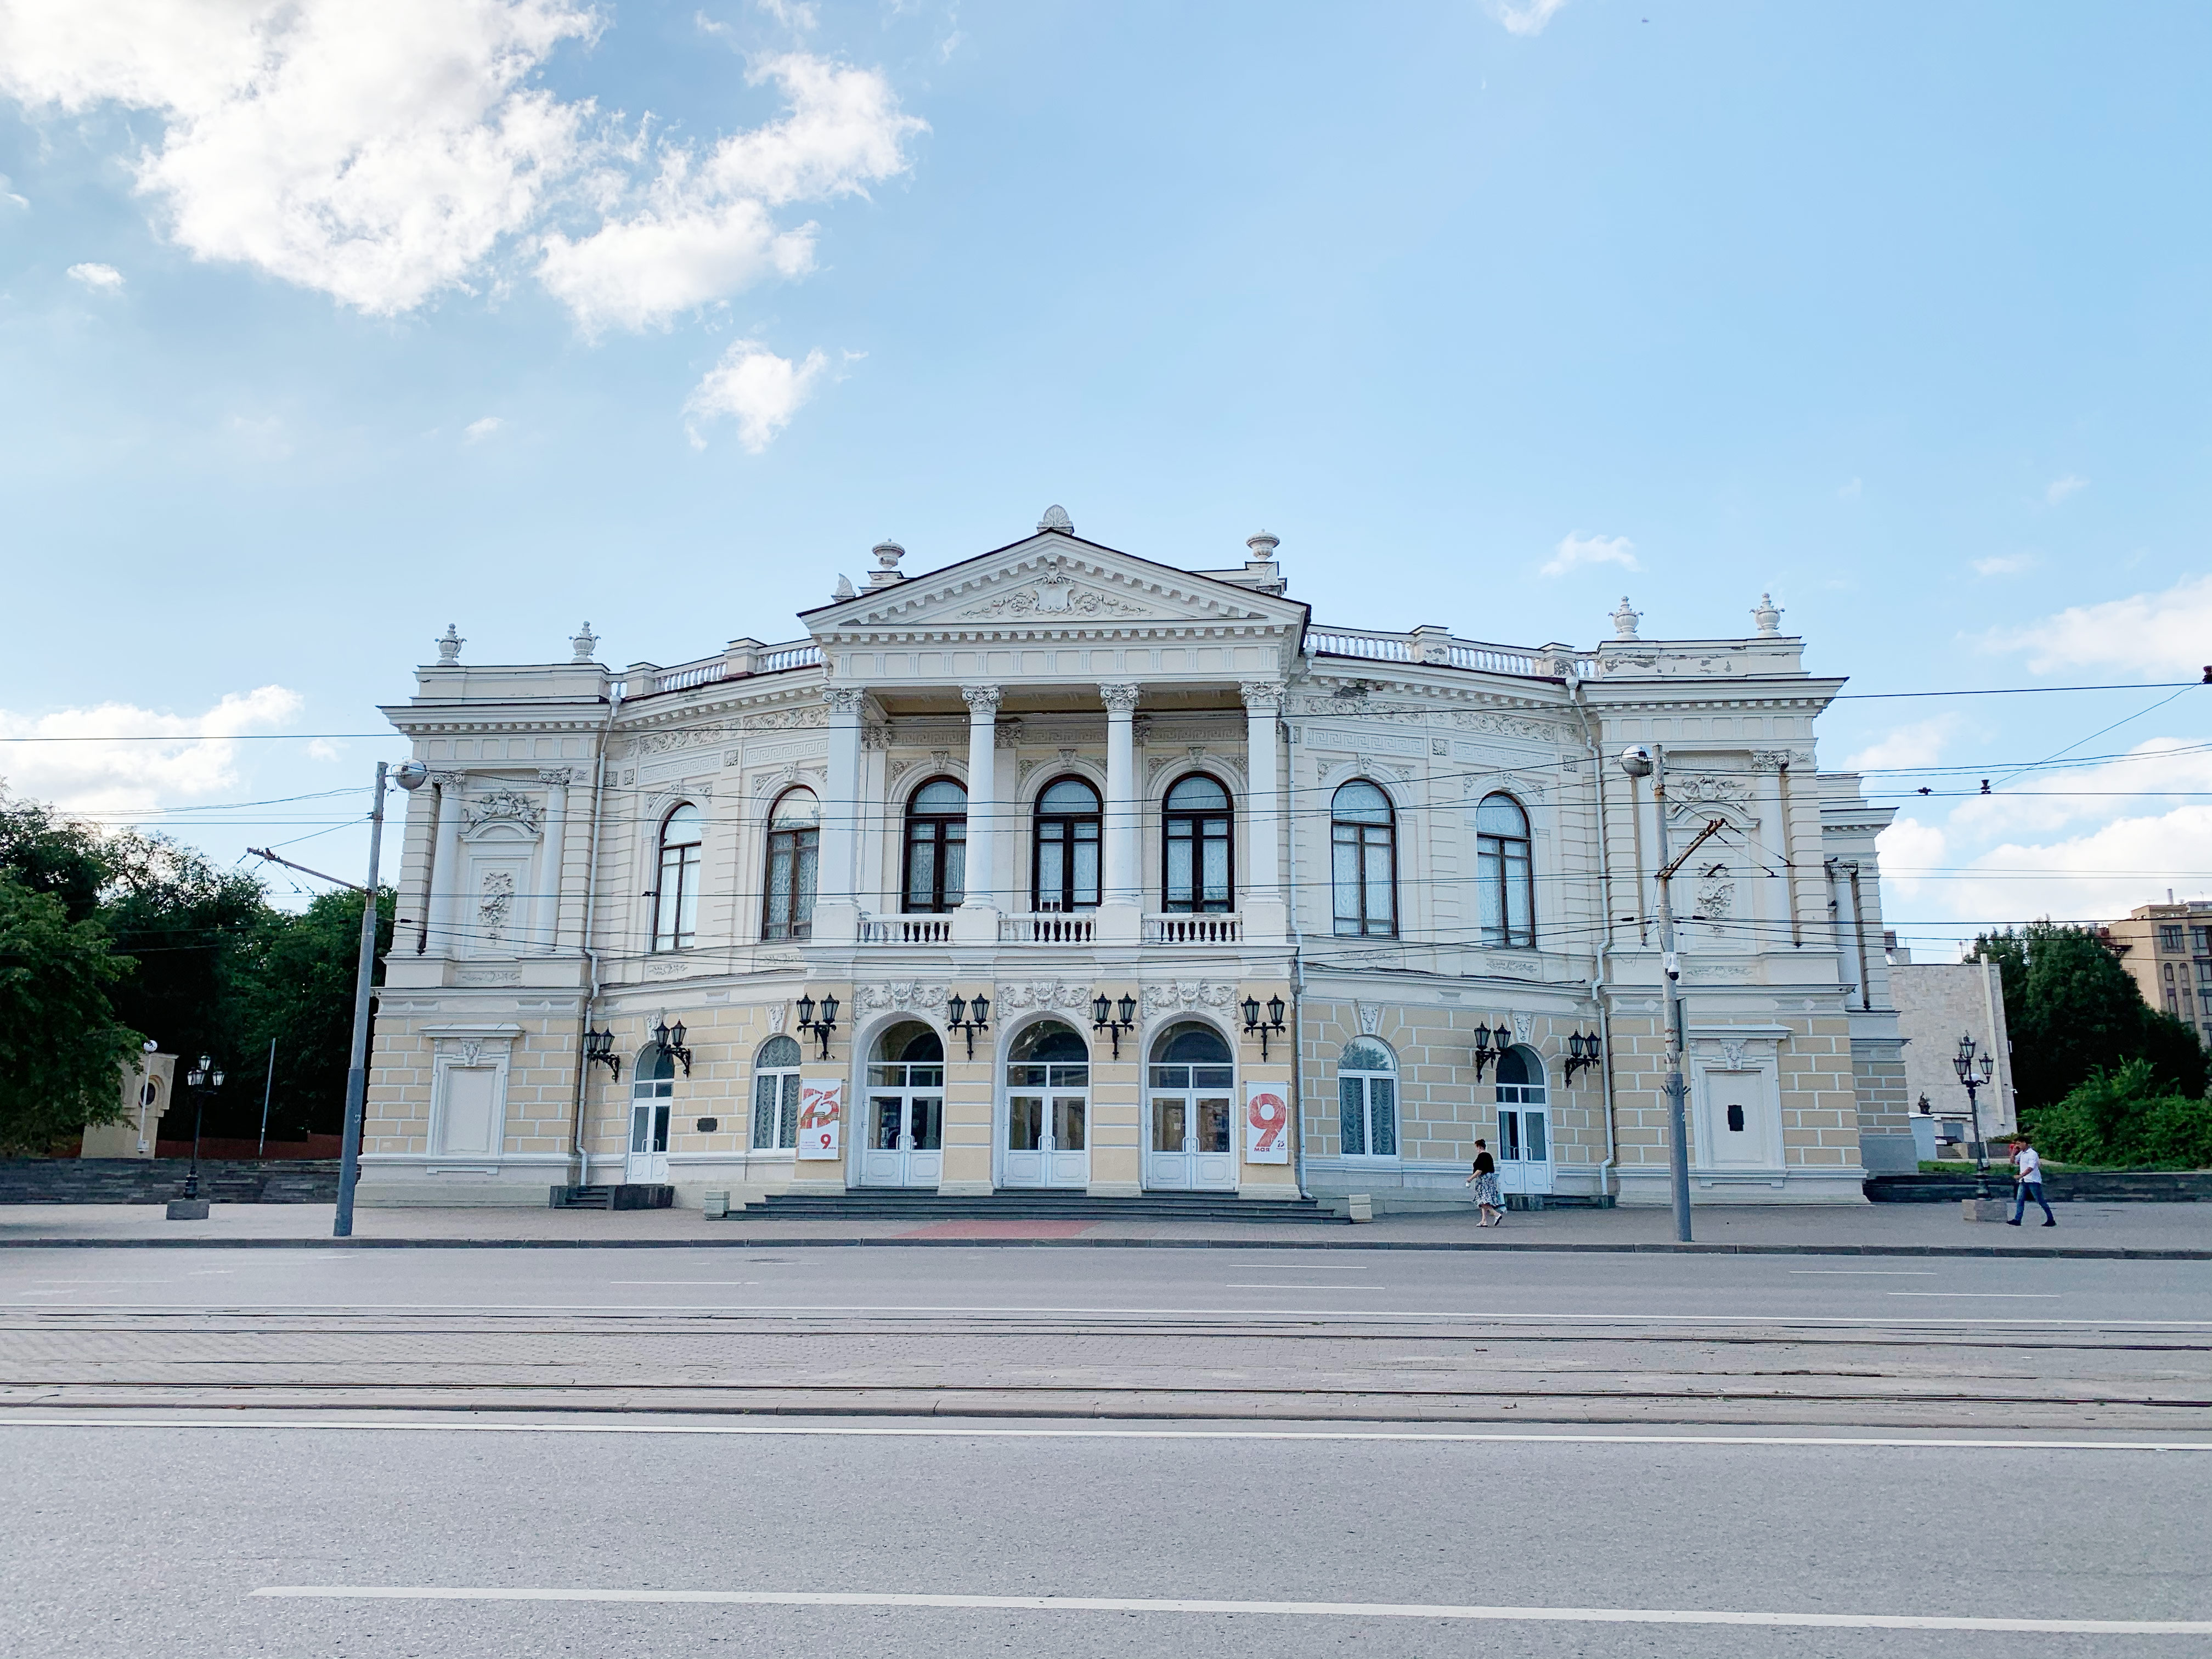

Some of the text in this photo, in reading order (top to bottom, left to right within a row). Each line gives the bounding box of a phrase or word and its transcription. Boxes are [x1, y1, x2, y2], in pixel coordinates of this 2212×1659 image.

[800, 1087, 840, 1129] 75
[1249, 1093, 1286, 1147] 9
[820, 1134, 831, 1149] 9
